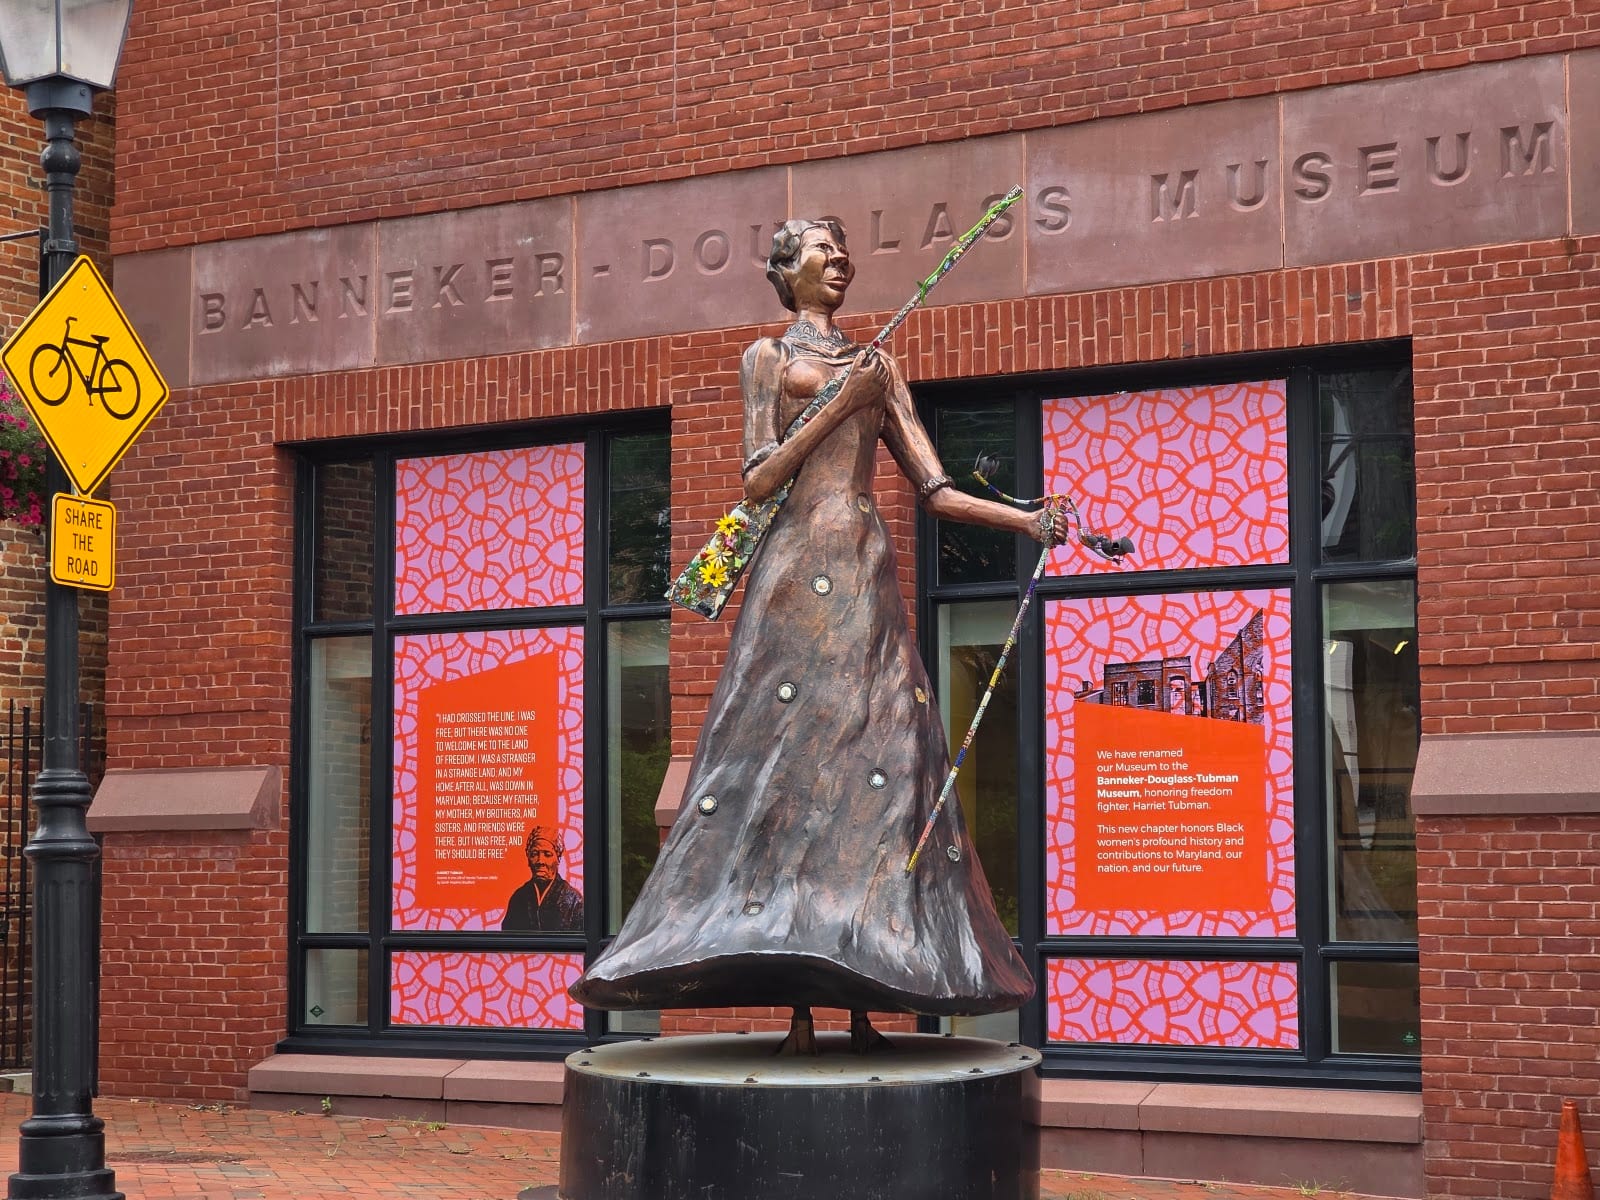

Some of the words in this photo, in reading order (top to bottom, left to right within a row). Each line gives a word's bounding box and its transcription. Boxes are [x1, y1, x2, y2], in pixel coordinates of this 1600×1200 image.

[1150, 120, 1557, 223] MUSEUM
[65, 508, 103, 530] SHARE
[72, 533, 94, 552] THE
[68, 556, 98, 577] ROAD
[443, 713, 456, 723] HAD
[457, 712, 485, 722] CROSSED
[487, 712, 499, 722] THE
[520, 711, 535, 720] WAS
[454, 727, 466, 738] BUT
[468, 726, 487, 737] THERE
[489, 726, 502, 736] WAS
[504, 726, 513, 736] NO
[515, 725, 528, 736] ONE
[436, 741, 444, 752] TO
[444, 740, 476, 751] WELCOME
[478, 740, 487, 750] ME
[489, 740, 496, 750] TO
[498, 740, 510, 750] THE
[512, 739, 528, 750] LAND
[436, 755, 444, 765] OF
[480, 754, 495, 764] WAS
[496, 753, 500, 763] A
[502, 753, 536, 763] STRANGER
[1097, 750, 1112, 760] We
[1115, 749, 1136, 759] have
[1139, 748, 1183, 758] renamed
[436, 769, 442, 778] IN
[443, 768, 448, 778] A
[448, 768, 477, 778] STRANGE
[498, 767, 512, 777] AND
[512, 767, 524, 777] MY
[1097, 764, 1114, 772] our
[1115, 763, 1157, 772] Museum
[1159, 762, 1170, 771] to
[1172, 761, 1189, 771] the
[436, 782, 454, 792] HOME
[455, 782, 474, 792] AFTER
[490, 781, 503, 791] WAS
[505, 780, 525, 791] DOWN
[526, 780, 533, 790] IN
[1097, 774, 1238, 786] Banneker-Douglass-Tubman
[1097, 790, 1142, 799] Museum,
[1144, 788, 1188, 798] honoring
[1190, 787, 1233, 797] freedom
[473, 795, 502, 805] BECAUSE
[502, 794, 513, 805] MY
[1133, 801, 1166, 811] Harriet
[1168, 800, 1211, 810] Tubman.
[436, 809, 445, 819] MY
[476, 809, 485, 819] MY
[523, 808, 537, 818] AND
[464, 822, 476, 832] AND
[478, 822, 505, 832] FRIENDS
[506, 822, 525, 832] WERE
[1097, 825, 1116, 834] This
[1140, 824, 1178, 834] chapter
[1180, 823, 1214, 833] honors
[1216, 823, 1244, 832] Black
[458, 836, 470, 846] BUT
[474, 836, 489, 846] WAS
[508, 836, 523, 846] AND
[1097, 838, 1140, 847] women's
[1142, 837, 1186, 848] profound
[1189, 836, 1222, 847] history
[1225, 836, 1244, 846] and
[435, 849, 451, 859] THEY
[452, 849, 477, 859] SHOULD
[478, 848, 486, 859] BE
[1097, 850, 1162, 860] contributions
[1163, 851, 1173, 859] to
[1226, 851, 1243, 859] our
[1133, 863, 1151, 872] and
[1153, 864, 1170, 872] our
[1172, 862, 1204, 872] future.
